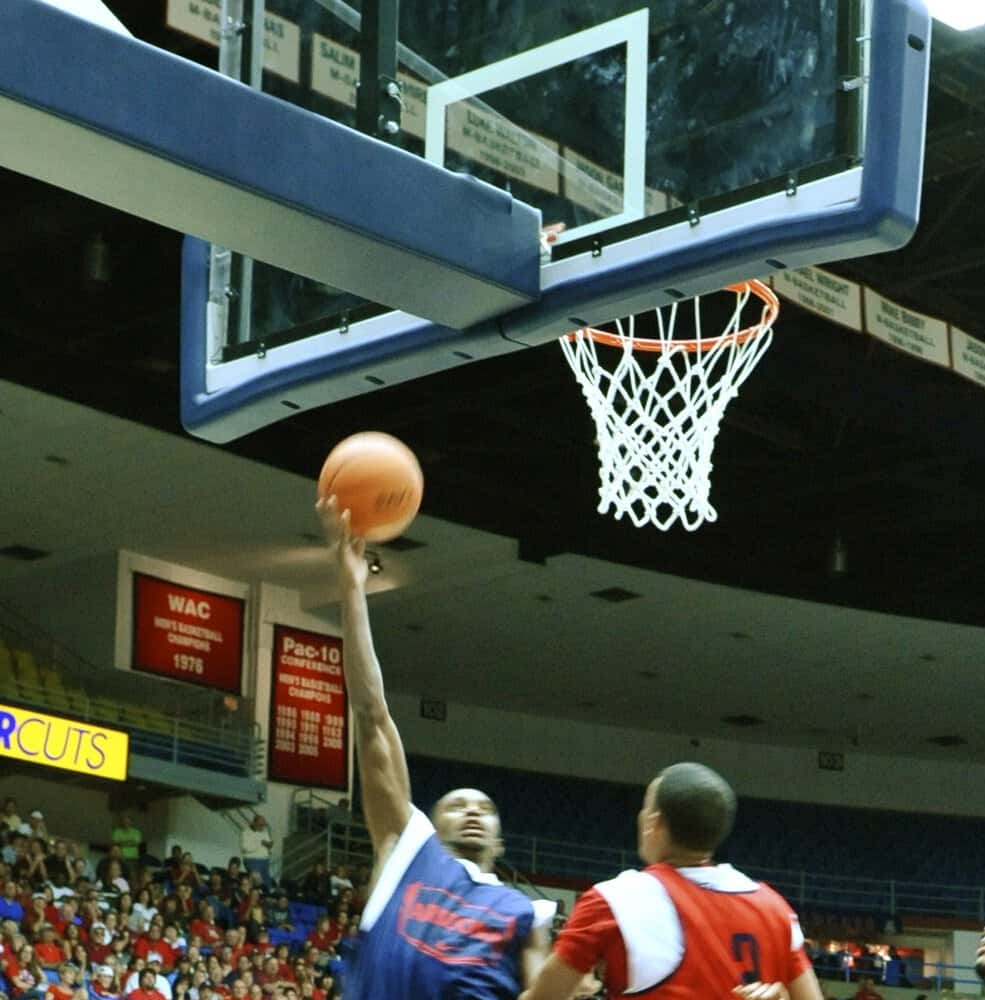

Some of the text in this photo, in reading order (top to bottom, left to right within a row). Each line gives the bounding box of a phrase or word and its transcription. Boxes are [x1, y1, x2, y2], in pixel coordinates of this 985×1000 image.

[168, 593, 211, 620] WAC
[282, 636, 341, 664] Pac-10
[173, 653, 204, 675] 1976
